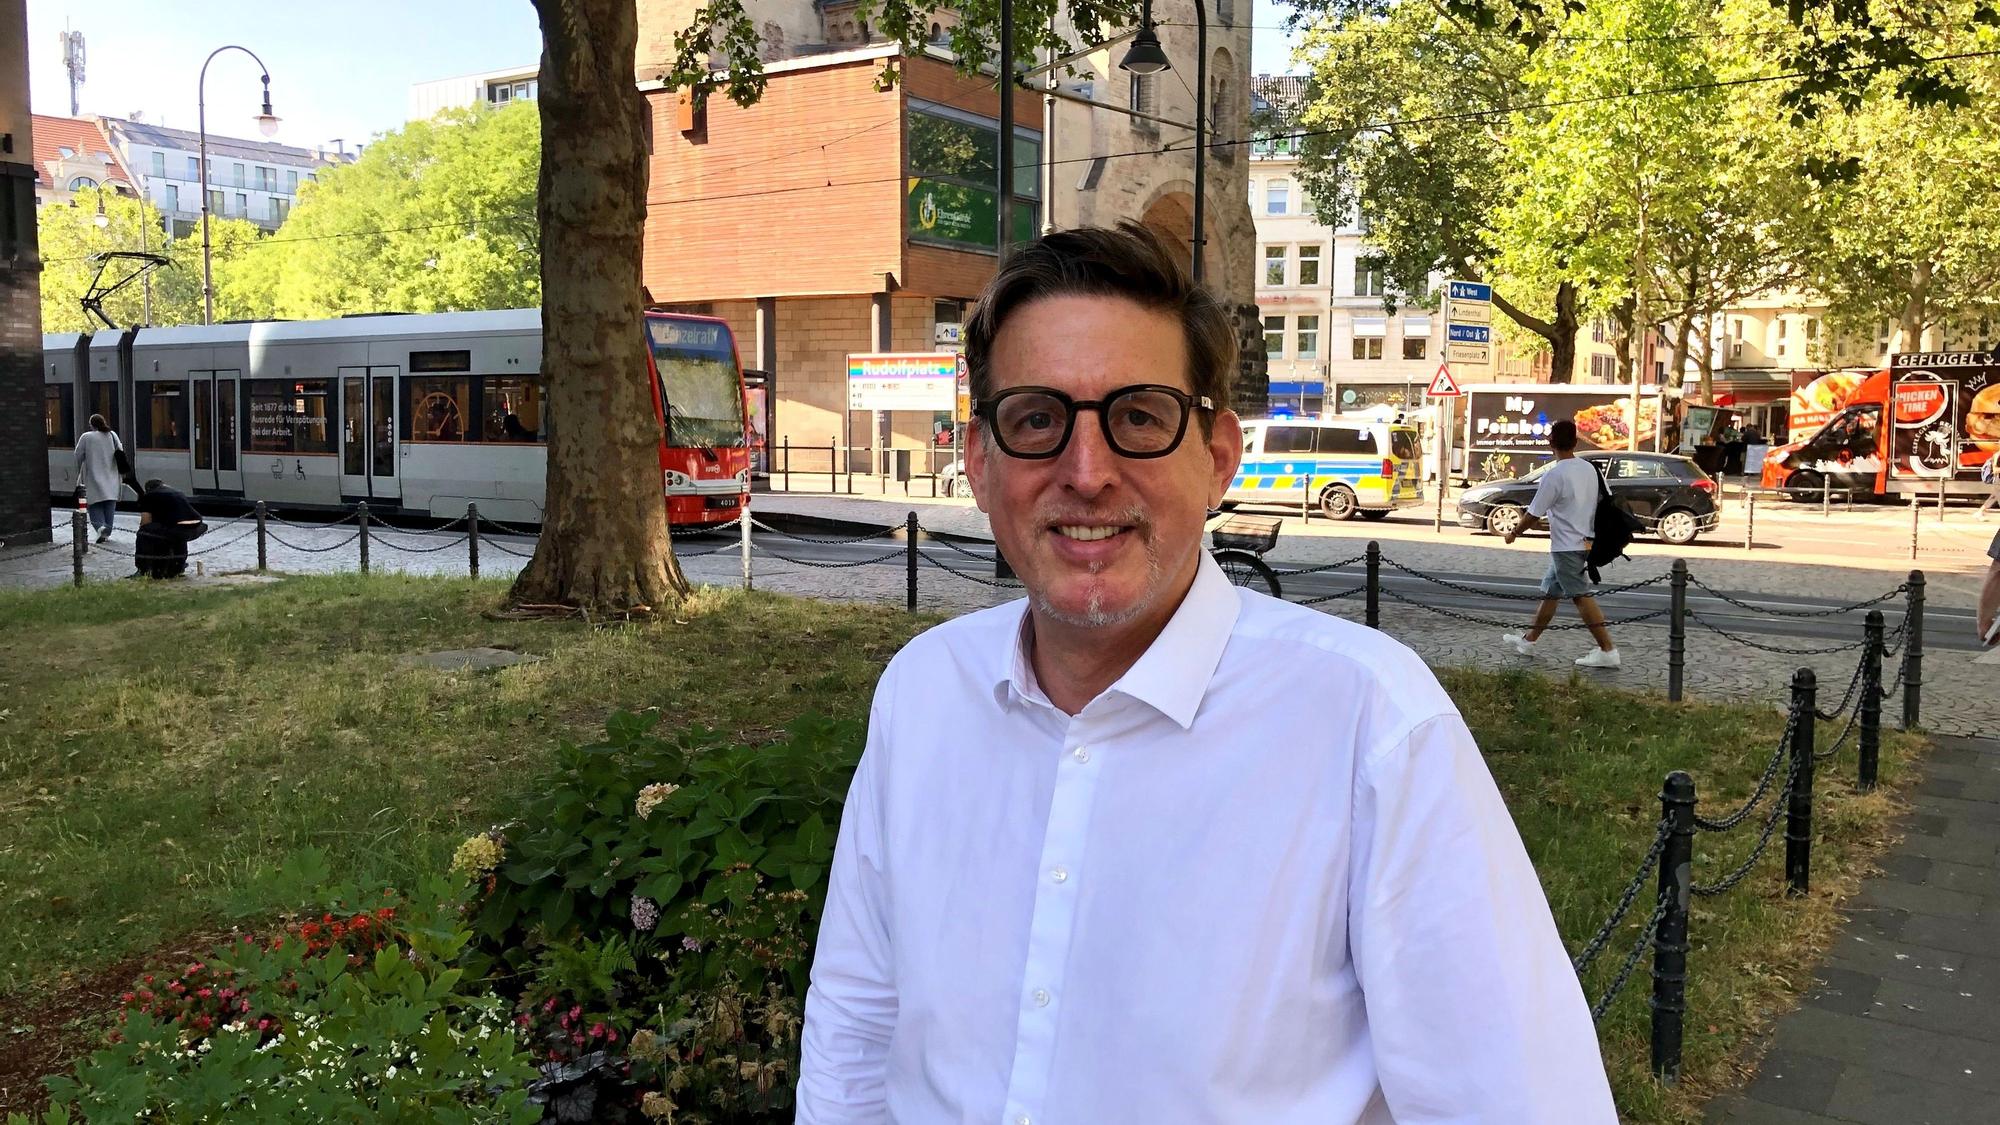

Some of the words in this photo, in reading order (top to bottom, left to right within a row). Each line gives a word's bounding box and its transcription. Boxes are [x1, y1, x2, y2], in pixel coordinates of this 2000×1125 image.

[1467, 287, 1478, 297] West
[1450, 329, 1461, 338] Nord
[1898, 354, 1977, 367] GEFLÜGEL
[862, 359, 940, 379] Rudolfplatz
[251, 402, 263, 411] Seit
[278, 402, 287, 411] die
[1505, 396, 1535, 415] My
[1903, 401, 1928, 413] TIME
[251, 415, 275, 424] Ausrede
[276, 414, 285, 423] für
[251, 427, 261, 436] bei
[262, 427, 271, 436] der
[1477, 418, 1557, 436] Feinkos
[720, 499, 736, 507] 4019
